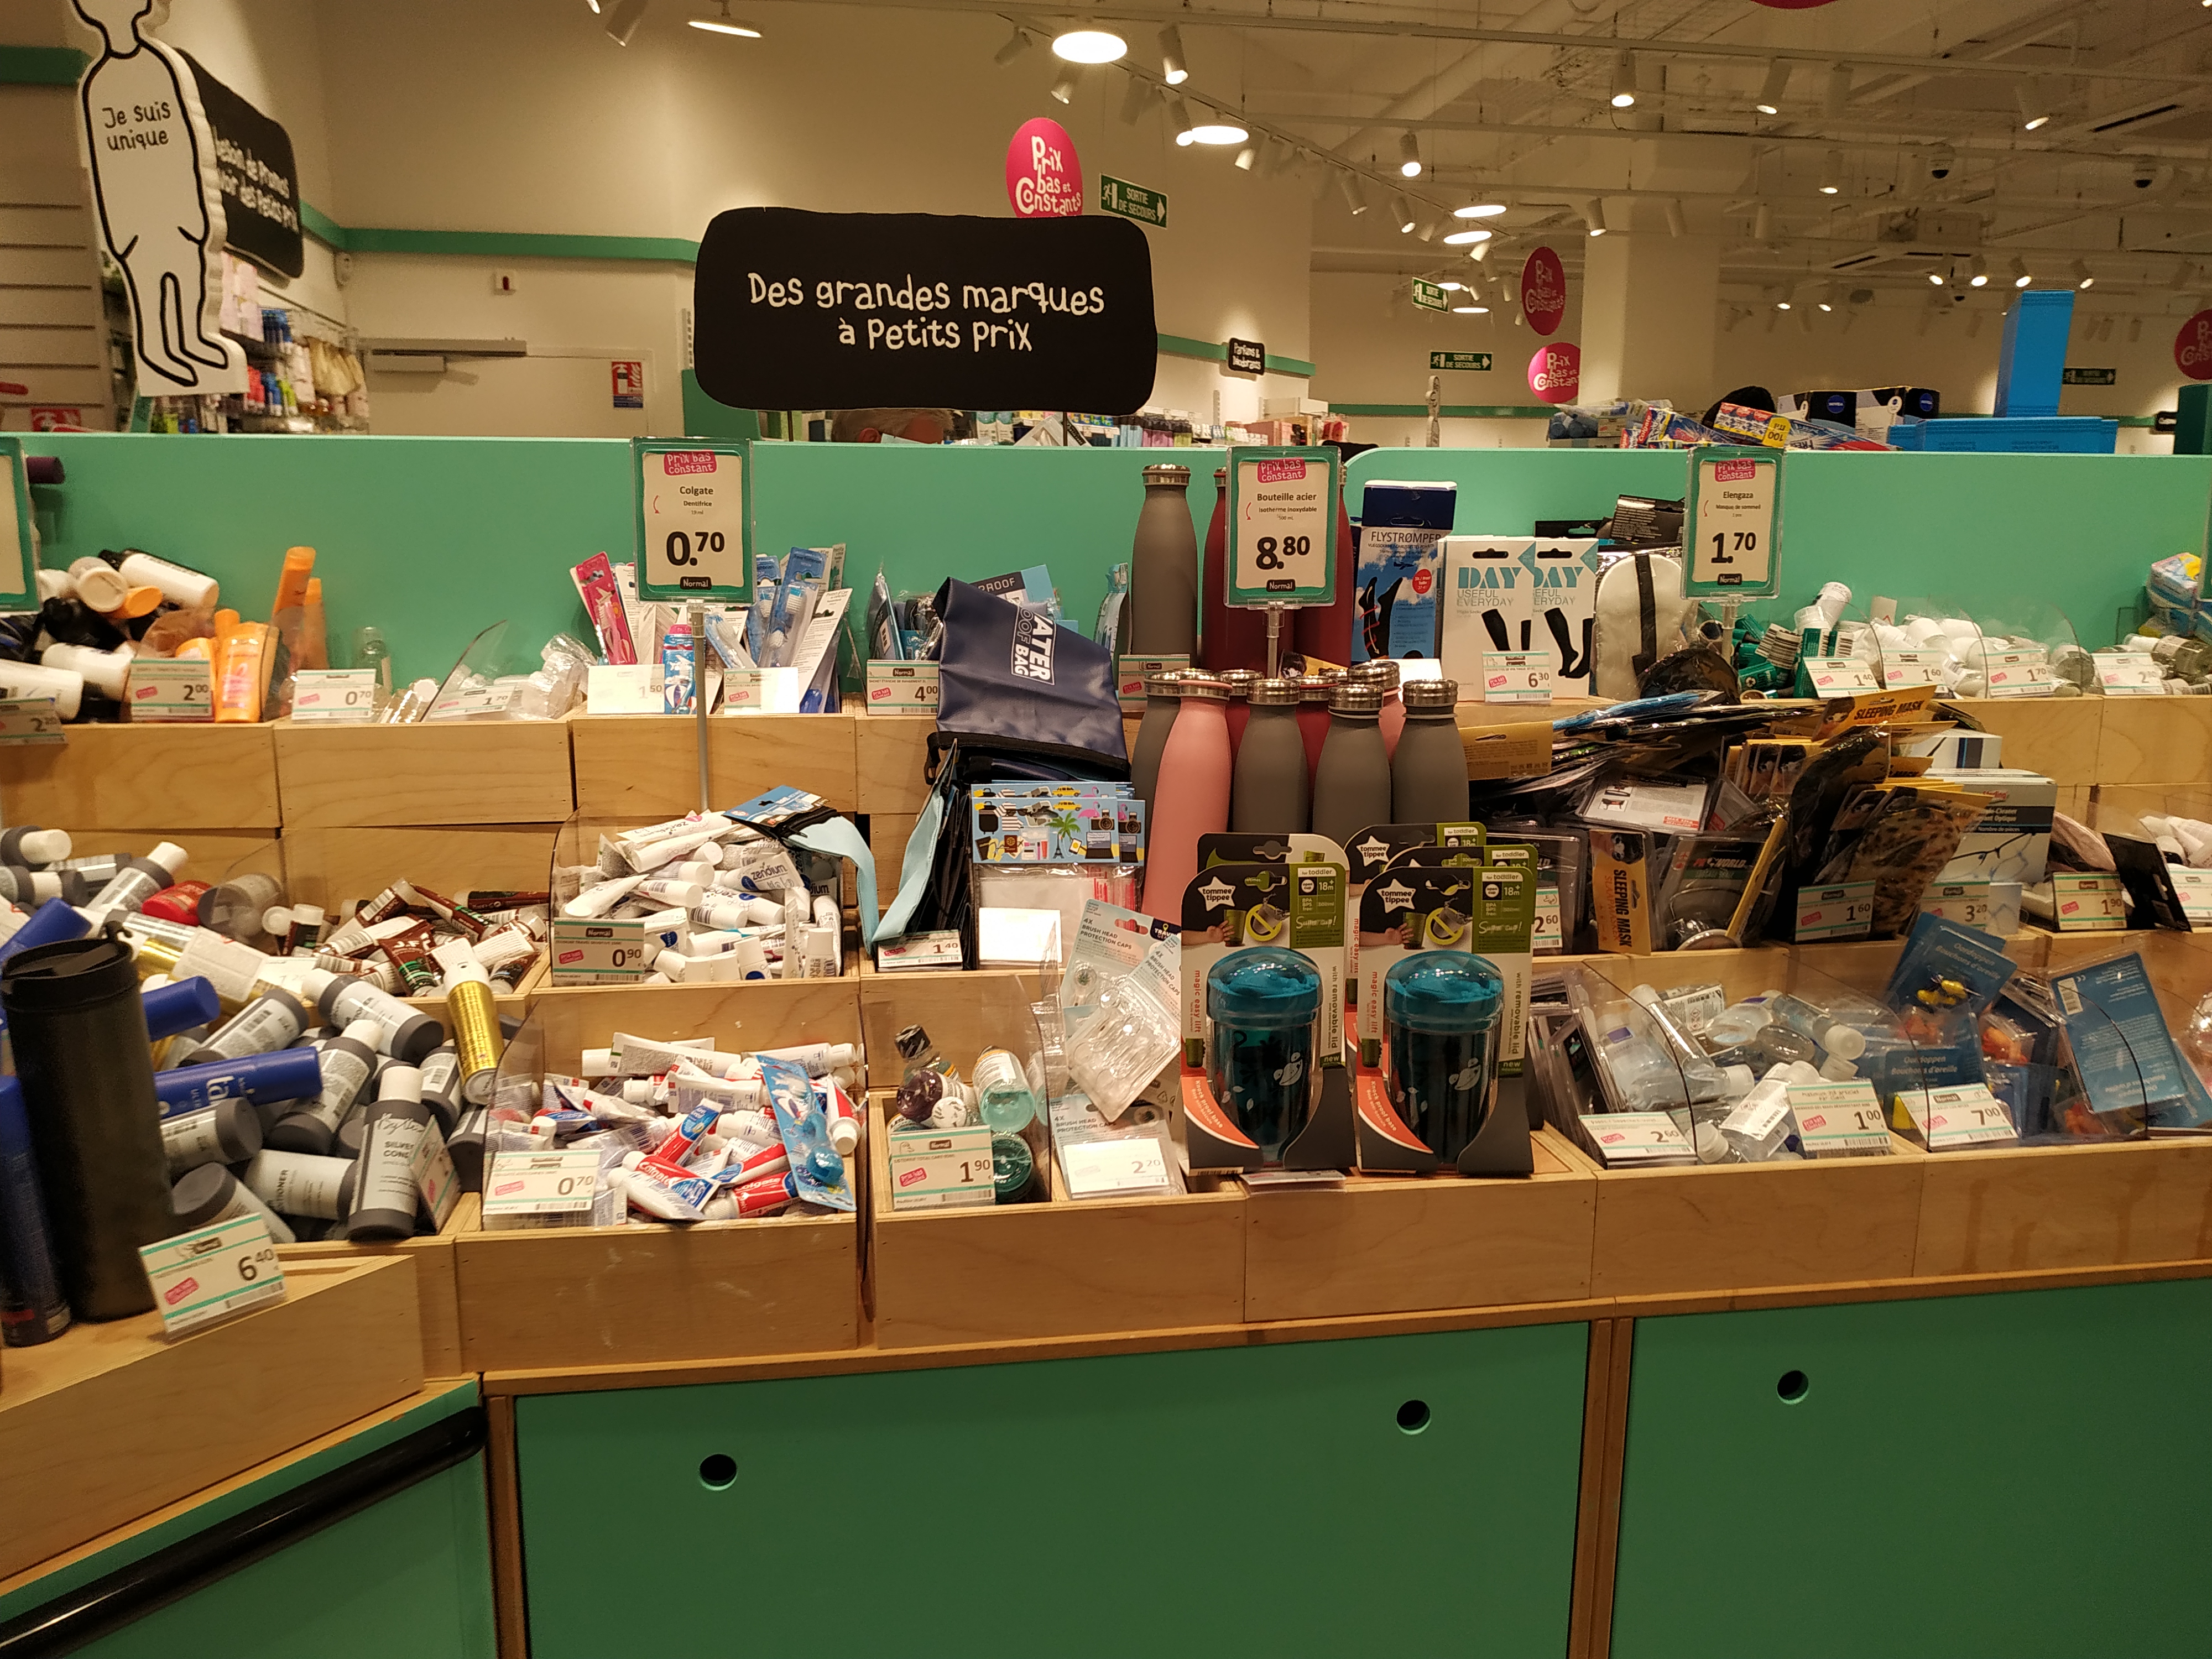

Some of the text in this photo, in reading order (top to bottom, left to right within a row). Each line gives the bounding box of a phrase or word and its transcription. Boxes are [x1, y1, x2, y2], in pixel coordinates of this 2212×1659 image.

[102, 101, 171, 128] Je suis
[107, 129, 170, 152] unique
[1031, 135, 1063, 175] Prix
[1037, 164, 1072, 194] bas et
[1015, 177, 1082, 215] Constants
[1126, 187, 1149, 204] SORTIE
[1118, 200, 1156, 221] DE SECOURS
[748, 272, 1105, 315] Des grandes marques
[839, 317, 855, 346] à
[1547, 352, 1571, 370] Prix
[1549, 368, 1567, 380] bas
[1639, 415, 1652, 442] Colgate
[692, 452, 711, 463] bas
[1284, 459, 1301, 469] bas
[669, 463, 714, 474] constant
[1261, 471, 1302, 482] constant
[680, 486, 714, 496] Colgate
[1257, 493, 1294, 501] Bouteille
[1723, 492, 1754, 500] Elengaza
[683, 579, 708, 587] Normal
[1270, 581, 1292, 590] Normal
[1458, 567, 1522, 589] DAY
[1457, 589, 1498, 598] USEFUL
[1457, 597, 1514, 606] EVERYDAY
[1014, 644, 1029, 676] BAG
[1854, 700, 1925, 720] SLEEPING MASK
[750, 863, 787, 880] zendium
[1614, 869, 1632, 947] SLEEPING MASK
[1080, 930, 1132, 950] PROTECTION CAPS
[1082, 924, 1118, 939] BRUSH HEAD
[1155, 950, 1164, 958] 4X
[1150, 955, 1164, 969] BRUSH
[1162, 967, 1175, 981] HEAD
[1145, 959, 1181, 996] PROTECTION CAPS
[1513, 990, 1521, 1040] removable
[1196, 1080, 1205, 1100] Knock
[1057, 1124, 1098, 1134] PROTECTION
[1386, 1117, 1397, 1131] base
